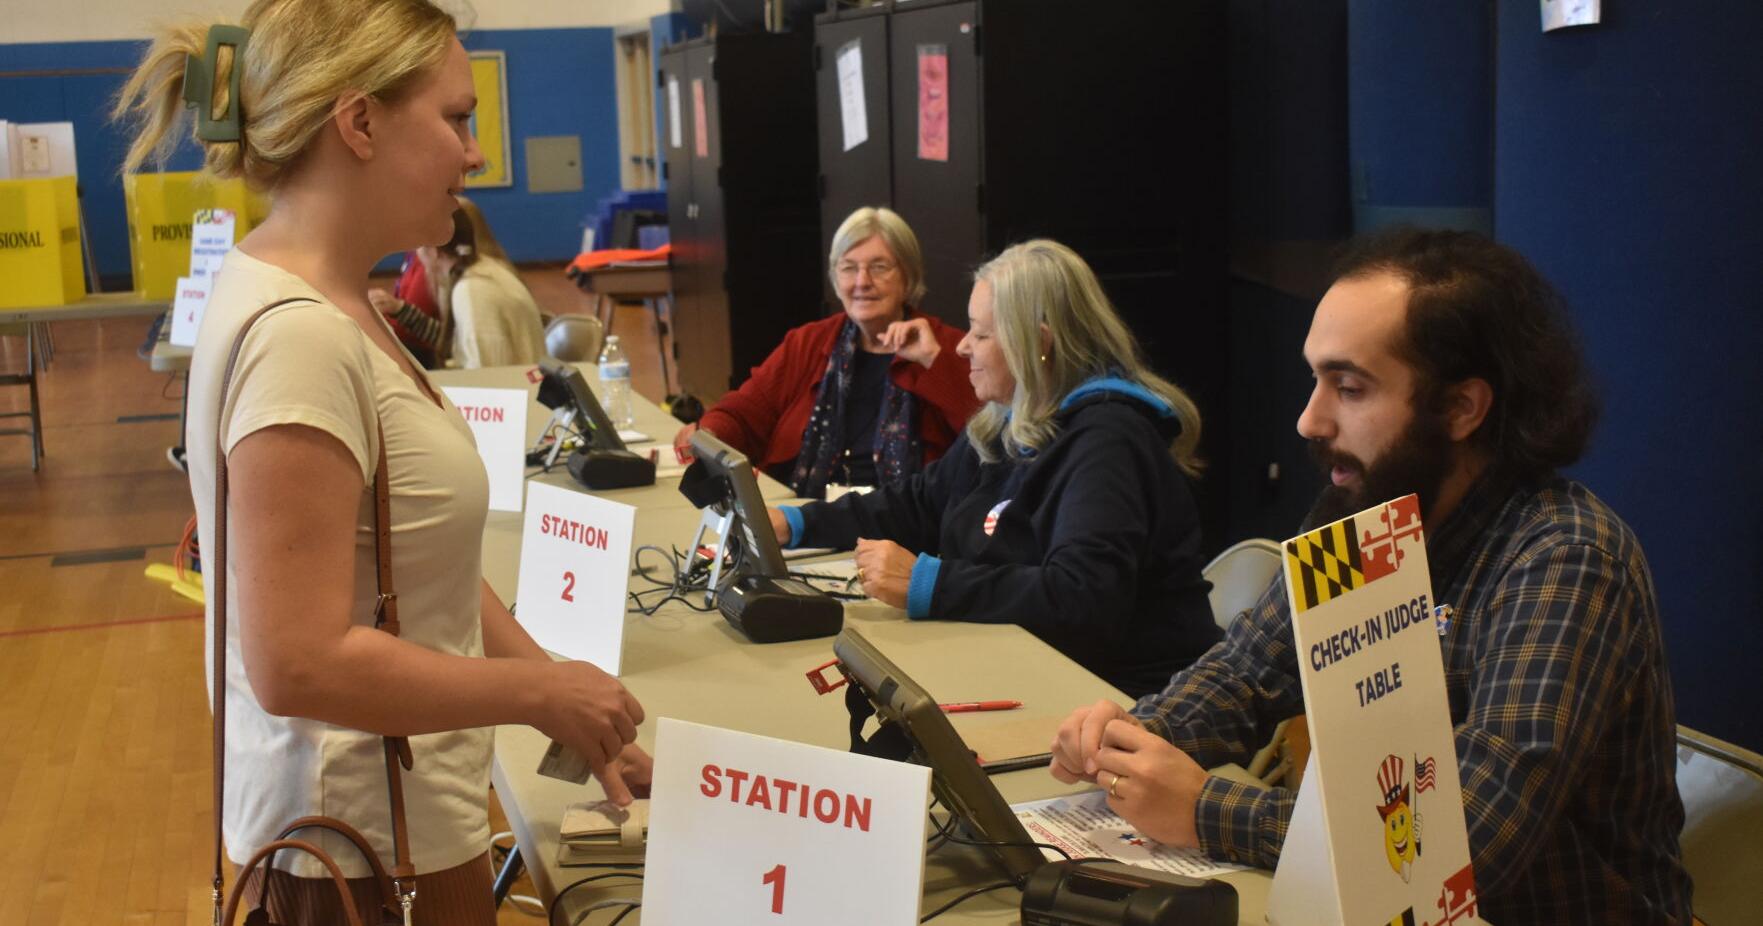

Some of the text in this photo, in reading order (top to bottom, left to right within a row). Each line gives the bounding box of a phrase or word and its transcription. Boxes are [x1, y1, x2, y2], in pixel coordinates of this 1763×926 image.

[457, 406, 505, 423] TION
[541, 513, 609, 551] STATION
[561, 571, 576, 602] 2
[1310, 594, 1430, 672] CHECK-IN JUDGE
[1355, 662, 1403, 708] TABLE
[700, 764, 872, 833] STATION
[762, 863, 787, 915] 1
